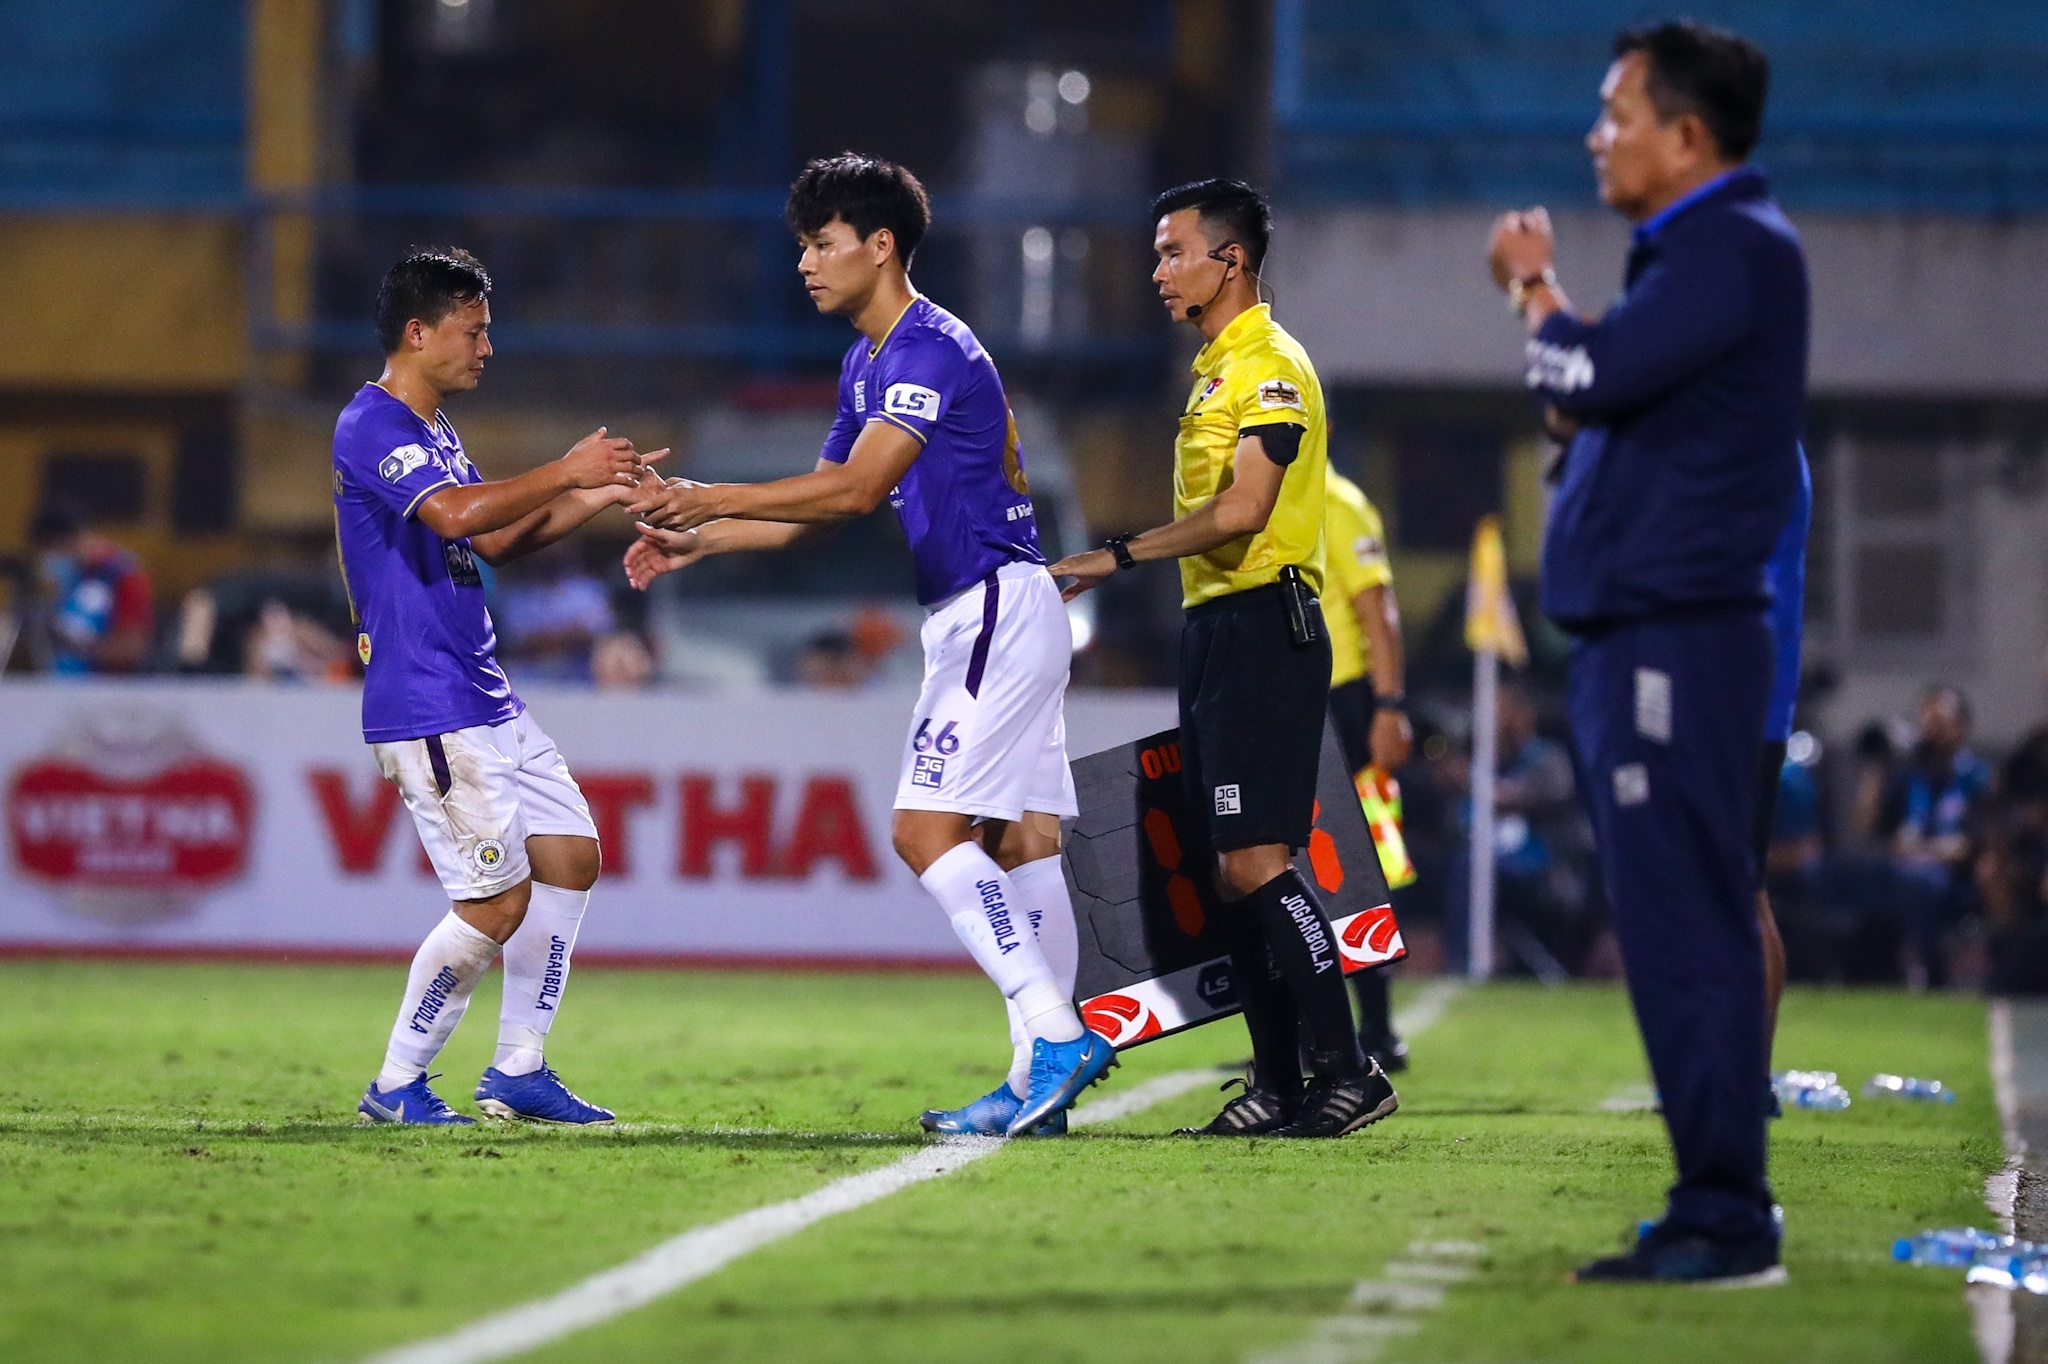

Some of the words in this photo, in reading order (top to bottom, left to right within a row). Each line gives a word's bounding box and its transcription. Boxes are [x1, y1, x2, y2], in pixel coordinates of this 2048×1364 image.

[891, 390, 928, 411] LS
[383, 462, 399, 479] LS
[913, 718, 960, 756] 66
[1141, 742, 1182, 779] OU
[308, 770, 657, 877] VT
[976, 878, 1020, 956] JOGARBOLA
[1280, 893, 1334, 975] JOGARBOLA
[410, 965, 460, 1035] JOGARBOLA
[535, 935, 566, 1011] JOGARBOLA
[1204, 975, 1230, 996] LS
